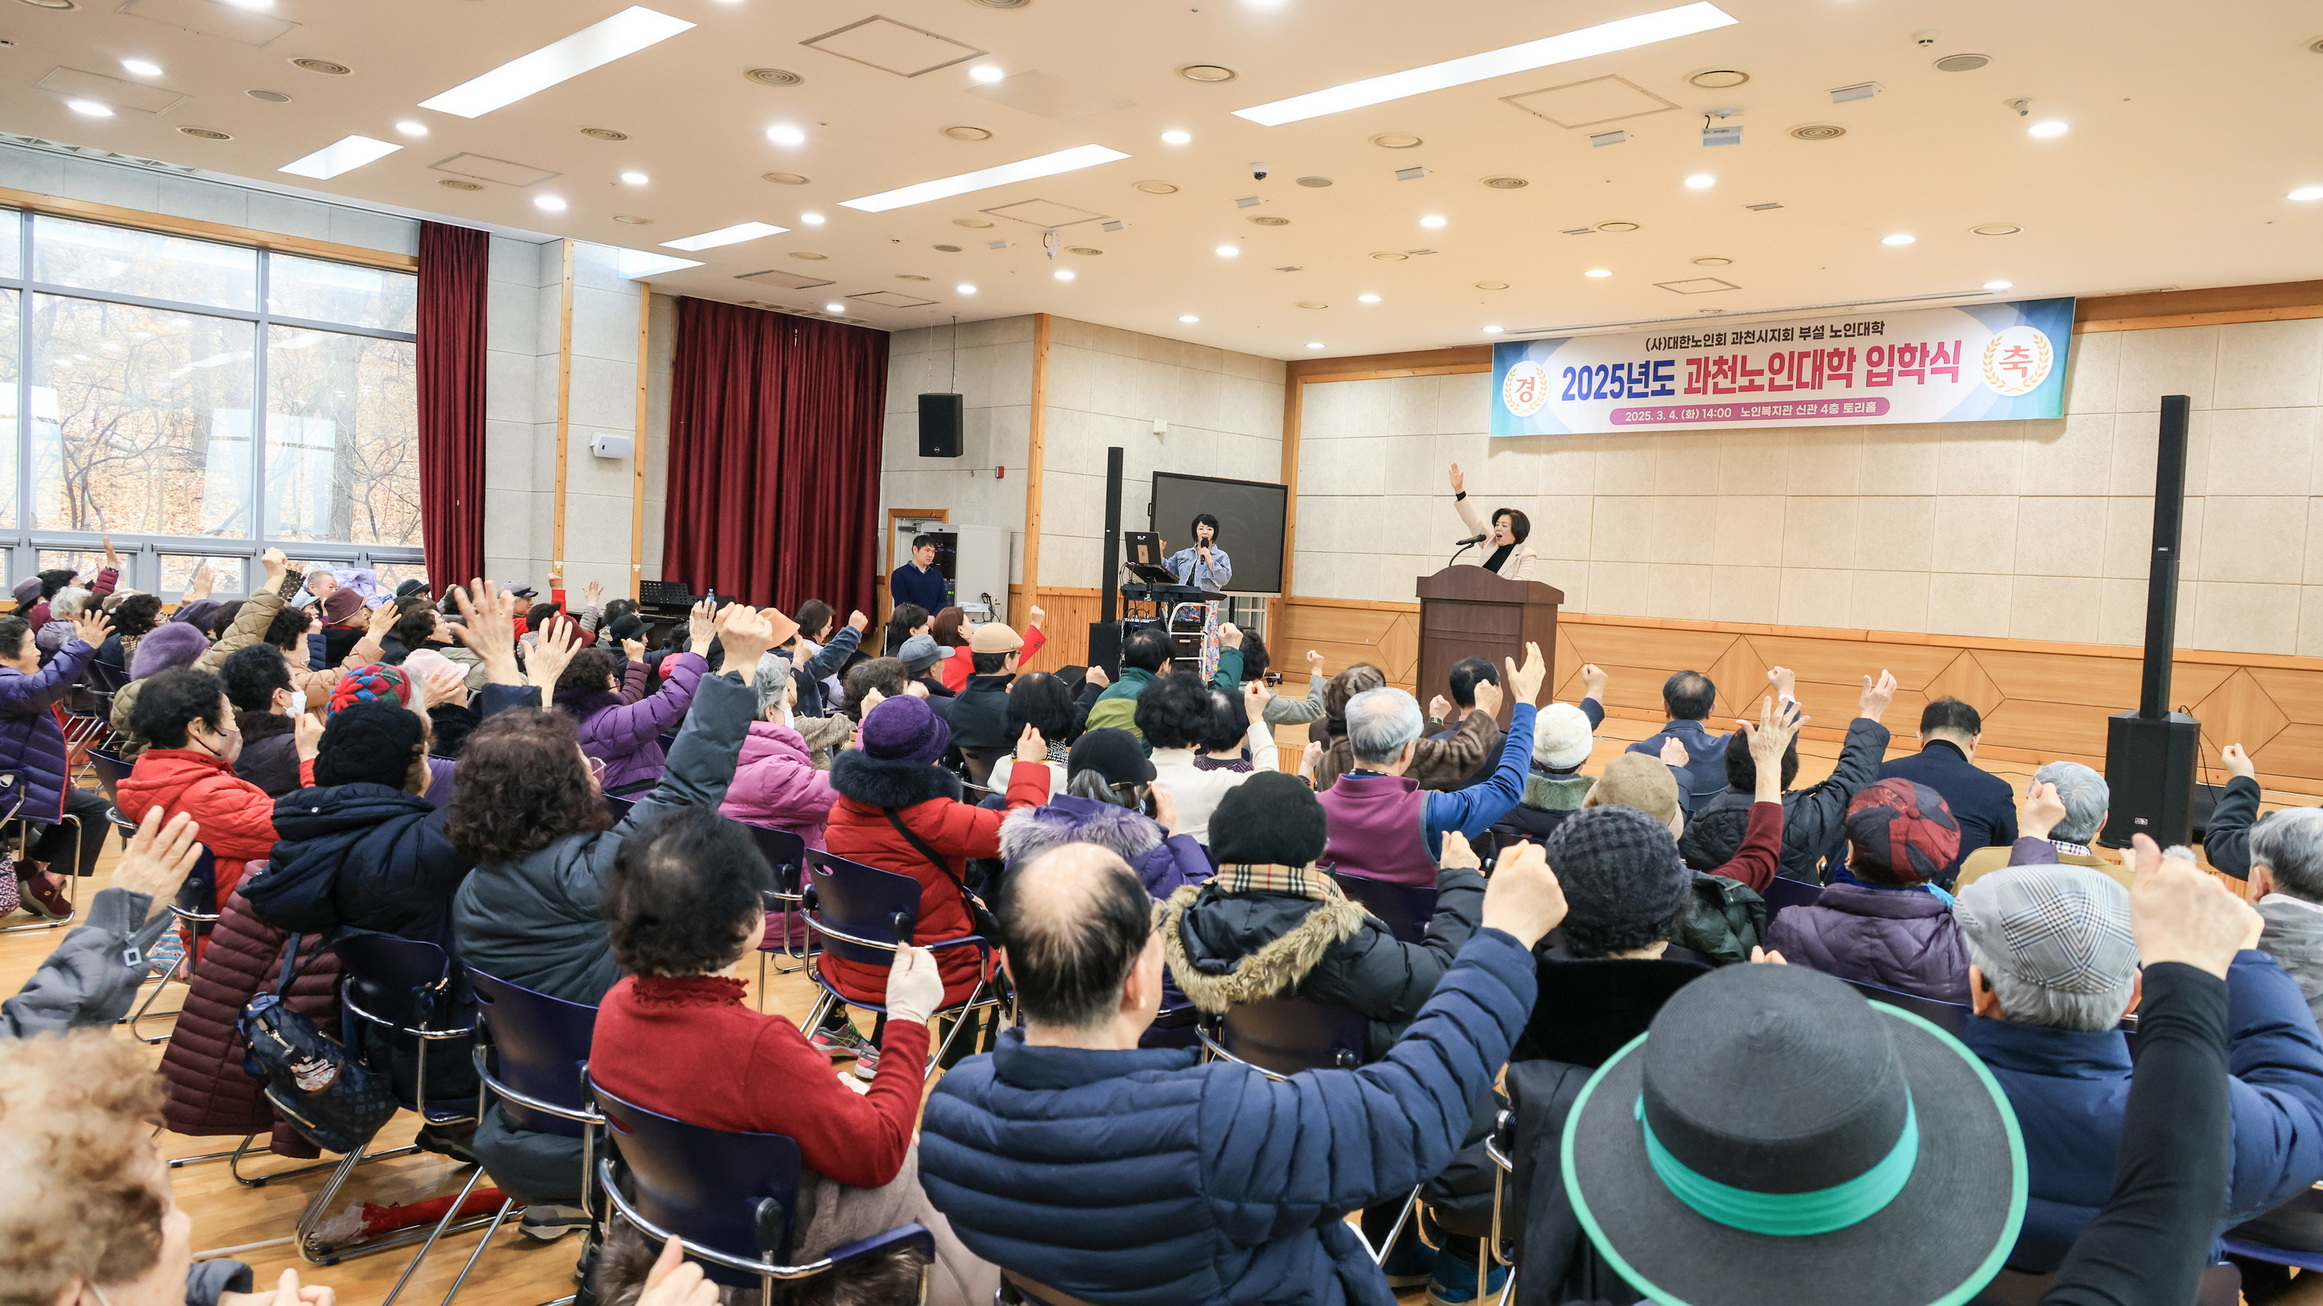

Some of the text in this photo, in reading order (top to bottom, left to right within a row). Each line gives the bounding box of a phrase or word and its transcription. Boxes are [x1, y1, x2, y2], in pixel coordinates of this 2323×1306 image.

[1645, 320, 1885, 352] (사)대한노인회 과천시지회 부설 노인대학
[1562, 340, 1962, 401] 2025년도 과천노인대학 입학식
[1998, 345, 2034, 379] 축
[1515, 376, 1535, 403] 경
[1625, 401, 1877, 422] 2025. 3. 4. (화) 14:00 노인복지관 신관 4층 토리홀
